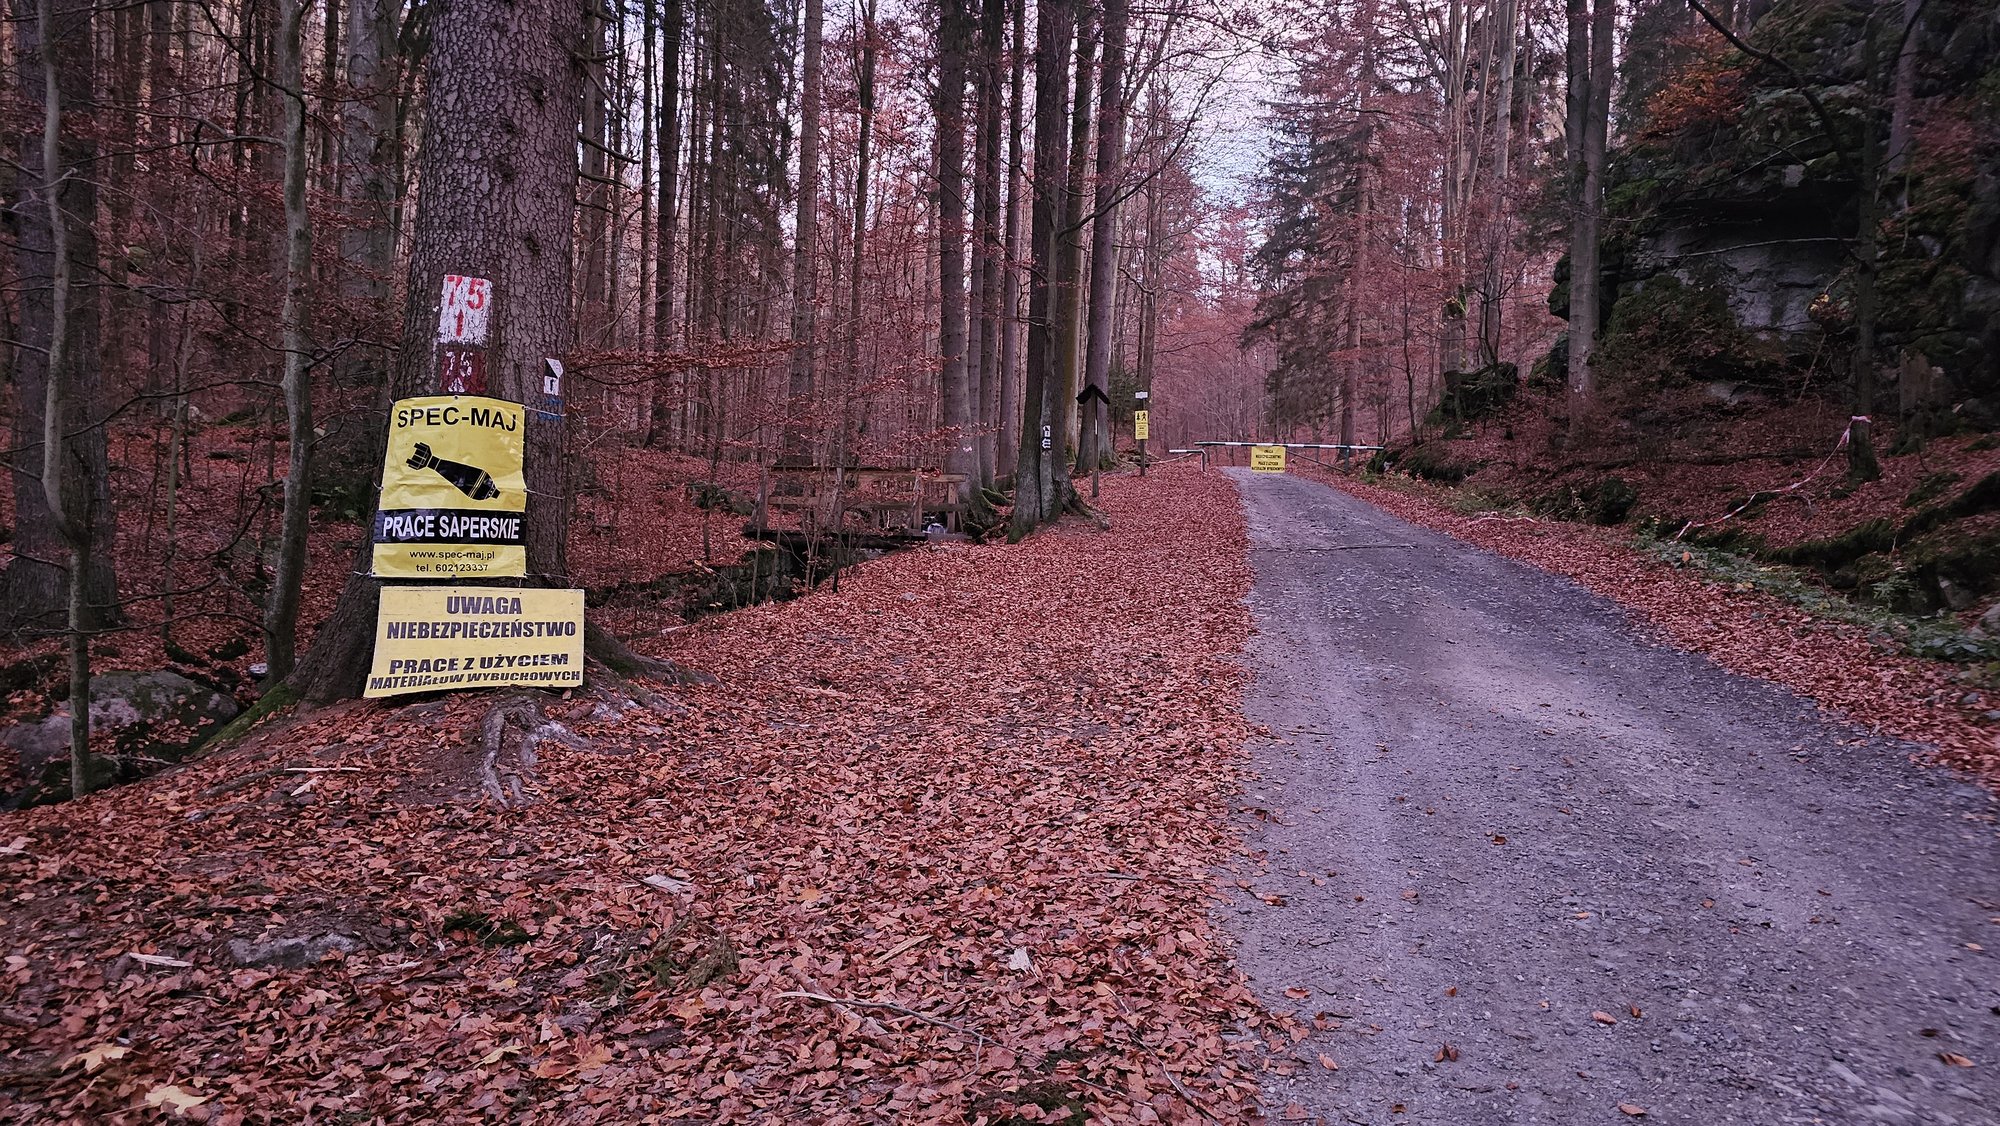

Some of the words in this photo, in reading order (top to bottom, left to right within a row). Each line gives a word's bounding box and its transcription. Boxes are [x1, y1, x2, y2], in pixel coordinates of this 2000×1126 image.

[446, 275, 485, 310] 75
[398, 407, 517, 431] SPEC-MAJ
[383, 515, 435, 537] PRACE
[439, 515, 521, 539] SAPERSKIE
[409, 551, 495, 560] www.spec-maj.pl
[416, 564, 432, 572] tel.
[435, 564, 488, 572] 602123337
[446, 596, 522, 614] UWAGA
[387, 619, 576, 639] NIEBEZPIECZEŃSTWO
[389, 658, 459, 674] PRACE
[463, 658, 475, 670] Z
[480, 654, 569, 669] UŻYCIEM
[467, 671, 580, 682] WYBUCHOWYCH
